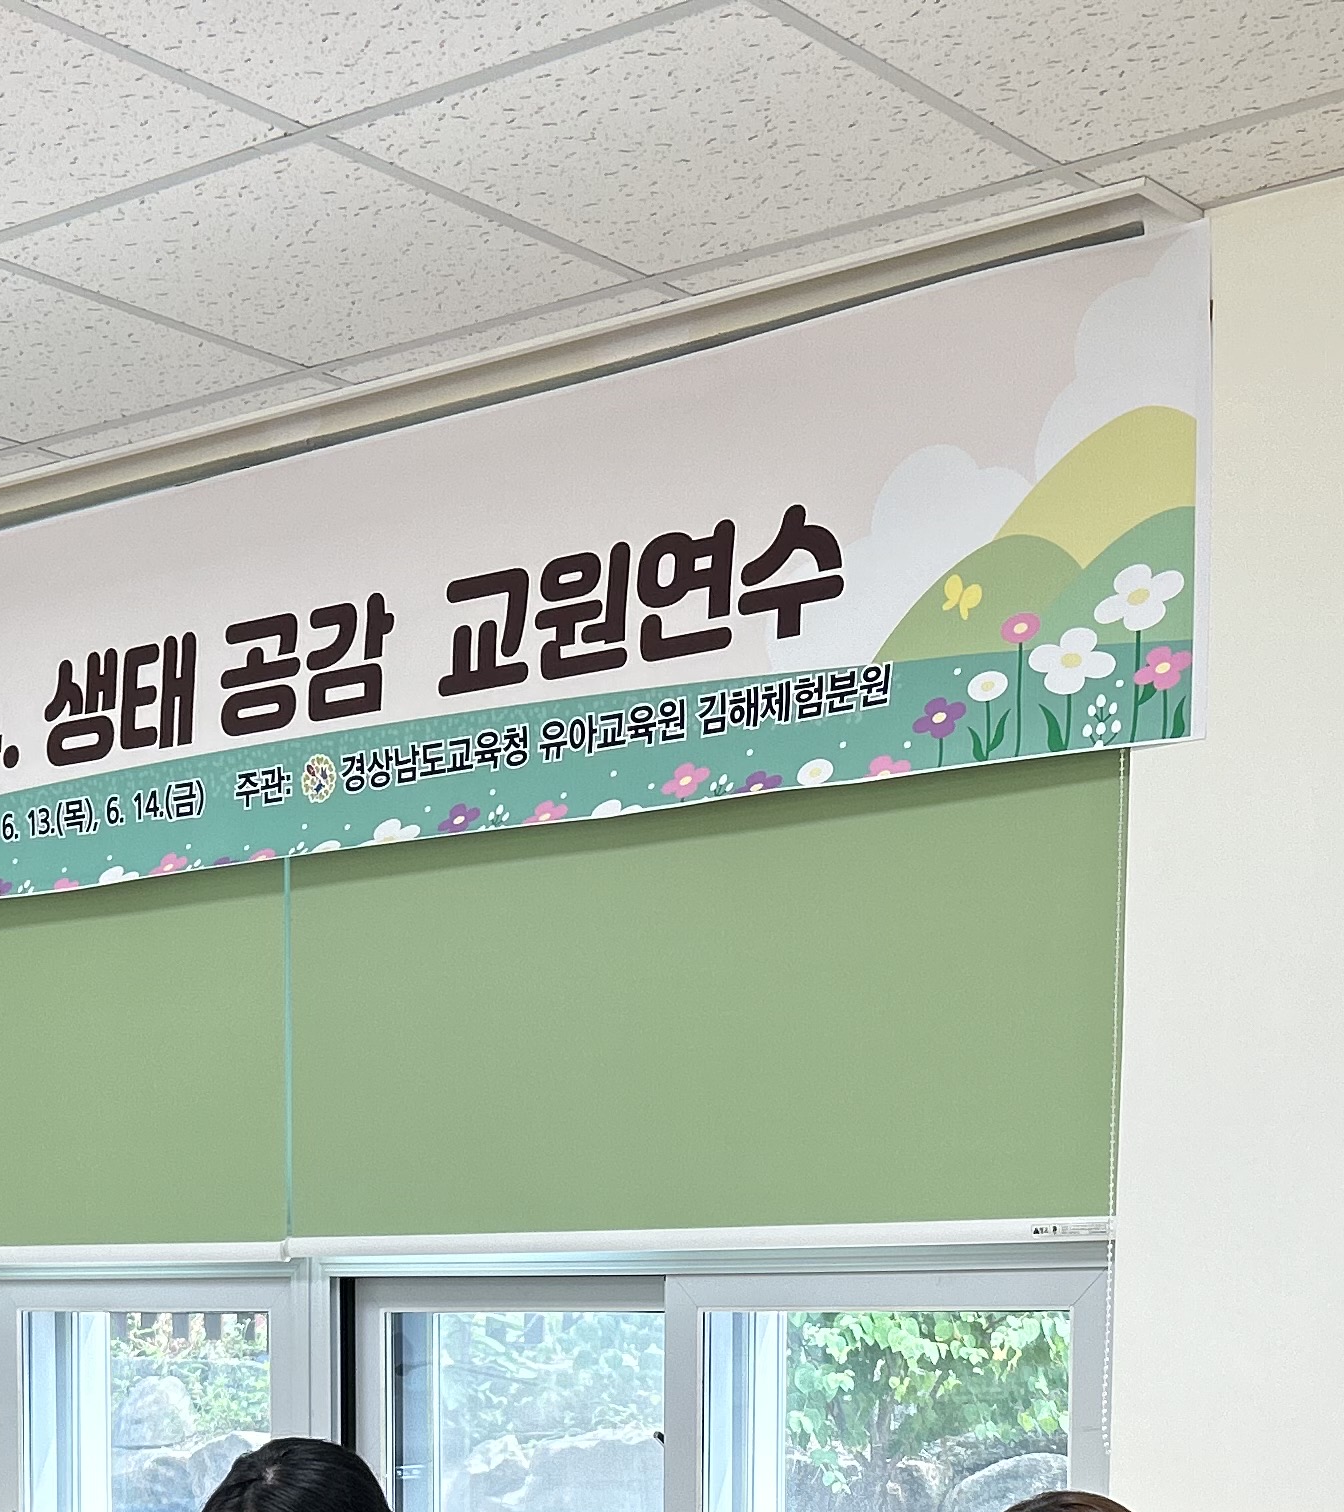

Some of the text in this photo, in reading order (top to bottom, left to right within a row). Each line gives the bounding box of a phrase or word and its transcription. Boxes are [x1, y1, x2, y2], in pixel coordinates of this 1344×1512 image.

[45, 631, 197, 769] 생태
[220, 592, 395, 738] 공감
[437, 503, 845, 698] 교원연수
[234, 661, 895, 810] 주관: 경상남도교육청 유아교육원 김해체험분원
[1, 814, 20, 843] 6.
[26, 798, 100, 839] 13.(목),
[105, 796, 126, 825] 6.
[133, 779, 206, 822] 14.(금)
